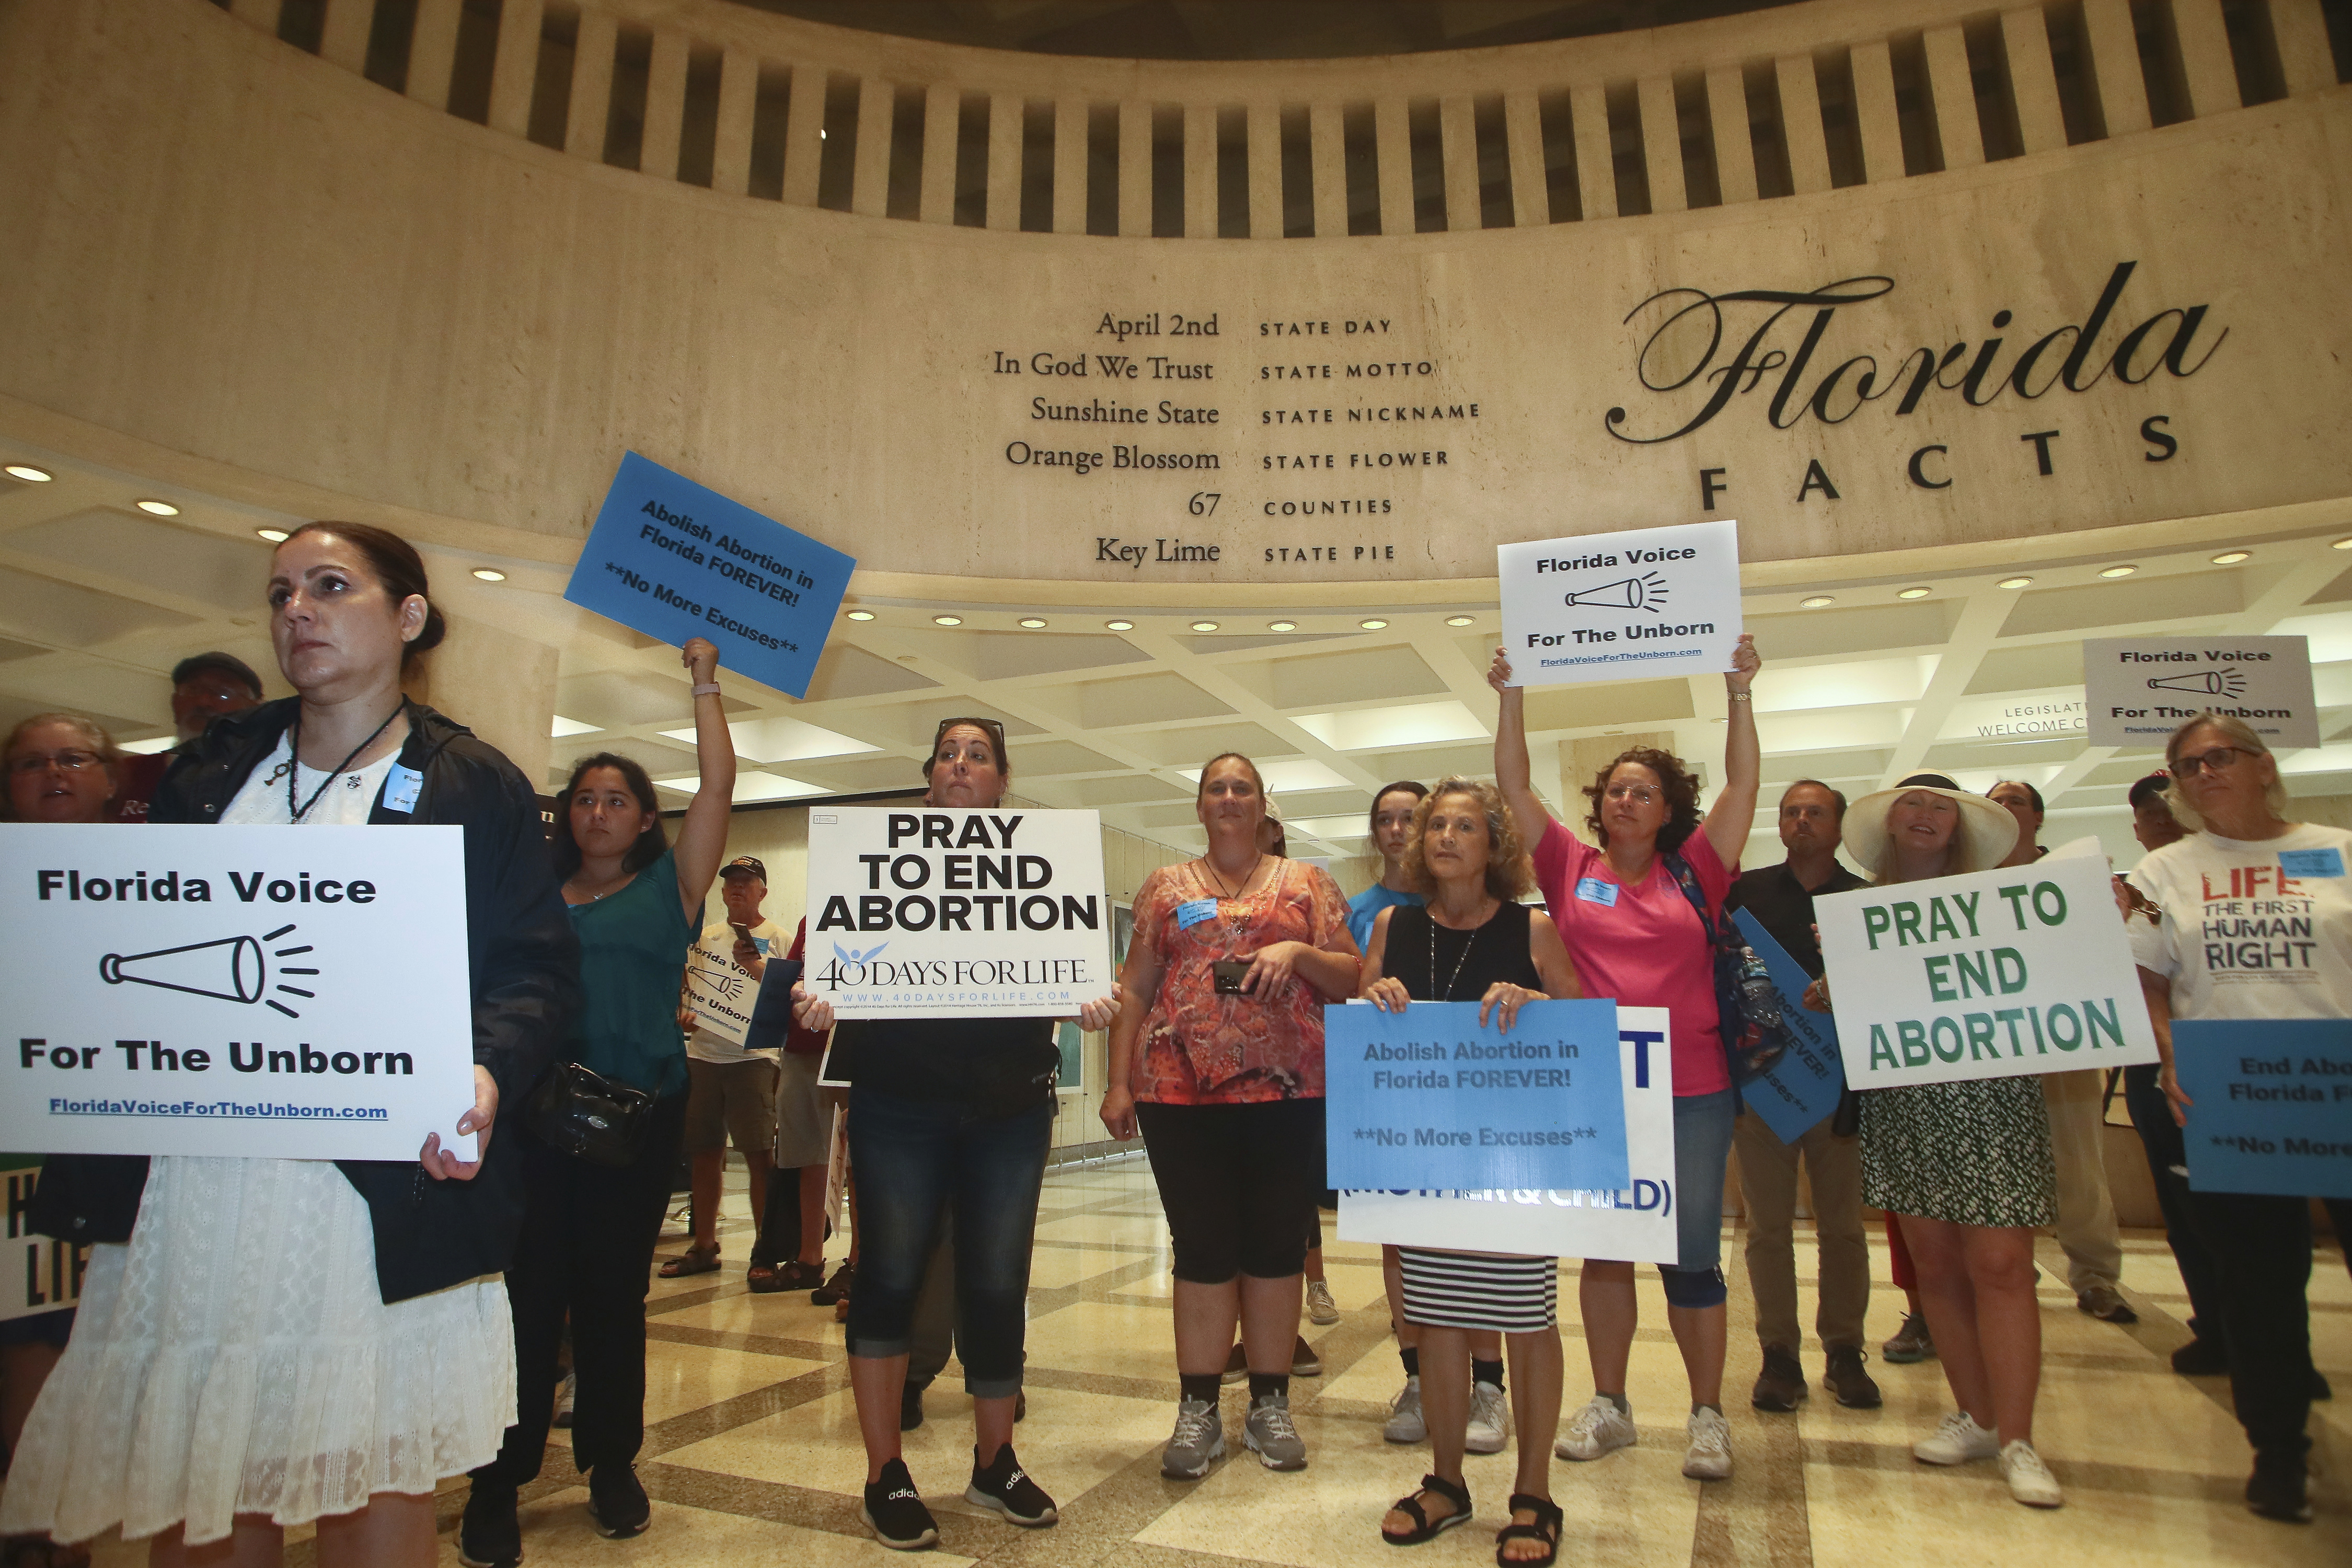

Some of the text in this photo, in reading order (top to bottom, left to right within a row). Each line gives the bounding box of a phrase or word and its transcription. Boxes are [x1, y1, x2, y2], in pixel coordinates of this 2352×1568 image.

[1097, 313, 1219, 342] April 2nd
[1260, 319, 1391, 336] STATE DAY
[1605, 260, 2229, 444] Florida
[994, 352, 1213, 380] In God We Trust
[1261, 361, 1432, 380] STATE MOTTO
[1031, 397, 1219, 424] Sunshine State
[1262, 404, 1480, 424] STATE NICKNAME
[1006, 441, 1220, 475] Orange Blossom
[1263, 451, 1448, 469] STATE FLOWER
[1700, 416, 2177, 510] FACTS
[1189, 492, 1221, 516] 67
[1264, 499, 1391, 515] COUNTIES
[641, 500, 814, 590] Abolish Abortion in
[1096, 538, 1220, 569] Key Lime
[1265, 546, 1394, 561] STATE PIE
[639, 524, 800, 607] Florida FOREVER!
[1537, 547, 1696, 573] Florida Voice
[653, 583, 702, 616] More
[1528, 622, 1714, 648] For The Unborn
[1541, 648, 1702, 666] FloridaVoiceForTheUnborn.com
[2120, 650, 2272, 663] Florida Voice
[2112, 707, 2148, 718] For
[2154, 707, 2197, 718] The
[1978, 719, 2067, 736] WELCOME
[888, 814, 1024, 849] PRAY
[859, 854, 1053, 890] TO END
[37, 870, 376, 904] Florida Voice
[815, 895, 1098, 932] ABORTION
[1862, 881, 2068, 950] PRAY TO
[2202, 900, 2314, 916] THE FIRST
[2203, 917, 2312, 939] HUMAN
[2205, 941, 2316, 970] RIGHT
[815, 956, 867, 991] 40
[871, 960, 947, 986] DAYS
[953, 960, 1016, 986] FOR
[1923, 947, 2027, 1002] END
[843, 992, 1069, 1002] WWW.40DAYSFORLIFE.COM
[1771, 987, 1836, 1060] bortion in
[1870, 998, 2126, 1071] ABORTION
[19, 1037, 414, 1075] For The Unborn
[1364, 1040, 1578, 1060] Abolish Abortion in
[1374, 1069, 1571, 1089] Florida FOREVER!
[2240, 1057, 2291, 1075] End
[2229, 1083, 2324, 1101] Florida
[49, 1098, 388, 1121] FloridaVoiceForTheUnborn.com
[1415, 1128, 1471, 1146] More
[2284, 1137, 2352, 1157] More
[27, 1240, 89, 1307] LIF
[889, 1488, 919, 1500] adida
